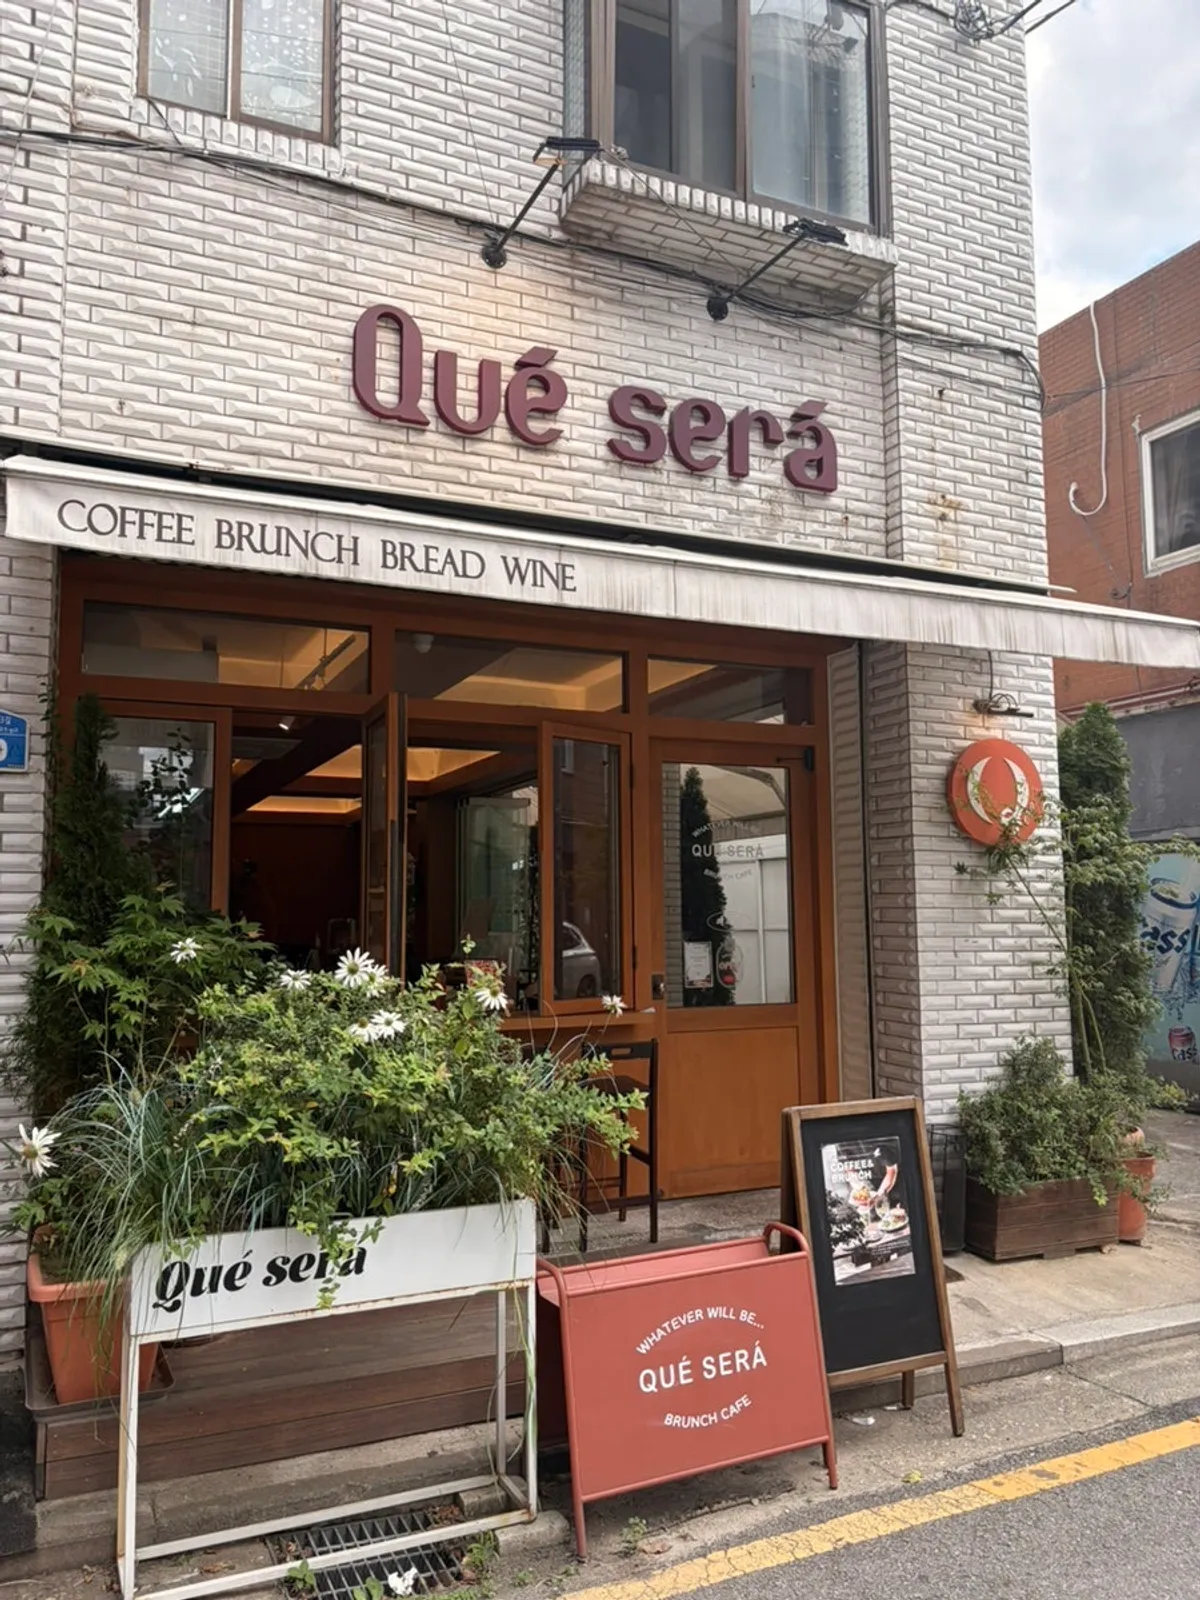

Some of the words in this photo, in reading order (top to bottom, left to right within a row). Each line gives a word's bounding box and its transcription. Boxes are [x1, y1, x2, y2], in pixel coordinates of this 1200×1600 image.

[352, 304, 568, 446] Qué
[607, 385, 838, 493] será
[57, 499, 196, 546] COFFEE
[214, 518, 360, 566] BRUNCH
[380, 538, 486, 580] BREAD
[500, 554, 577, 593] WINE
[152, 1250, 253, 1313] Qué
[636, 1308, 704, 1354] WHATEVER
[706, 1306, 736, 1320] WILL
[639, 1355, 694, 1393] QUÉ
[702, 1340, 767, 1379] SERÁ
[664, 1413, 718, 1428] BRUNCH
[720, 1394, 752, 1420] CAFE
